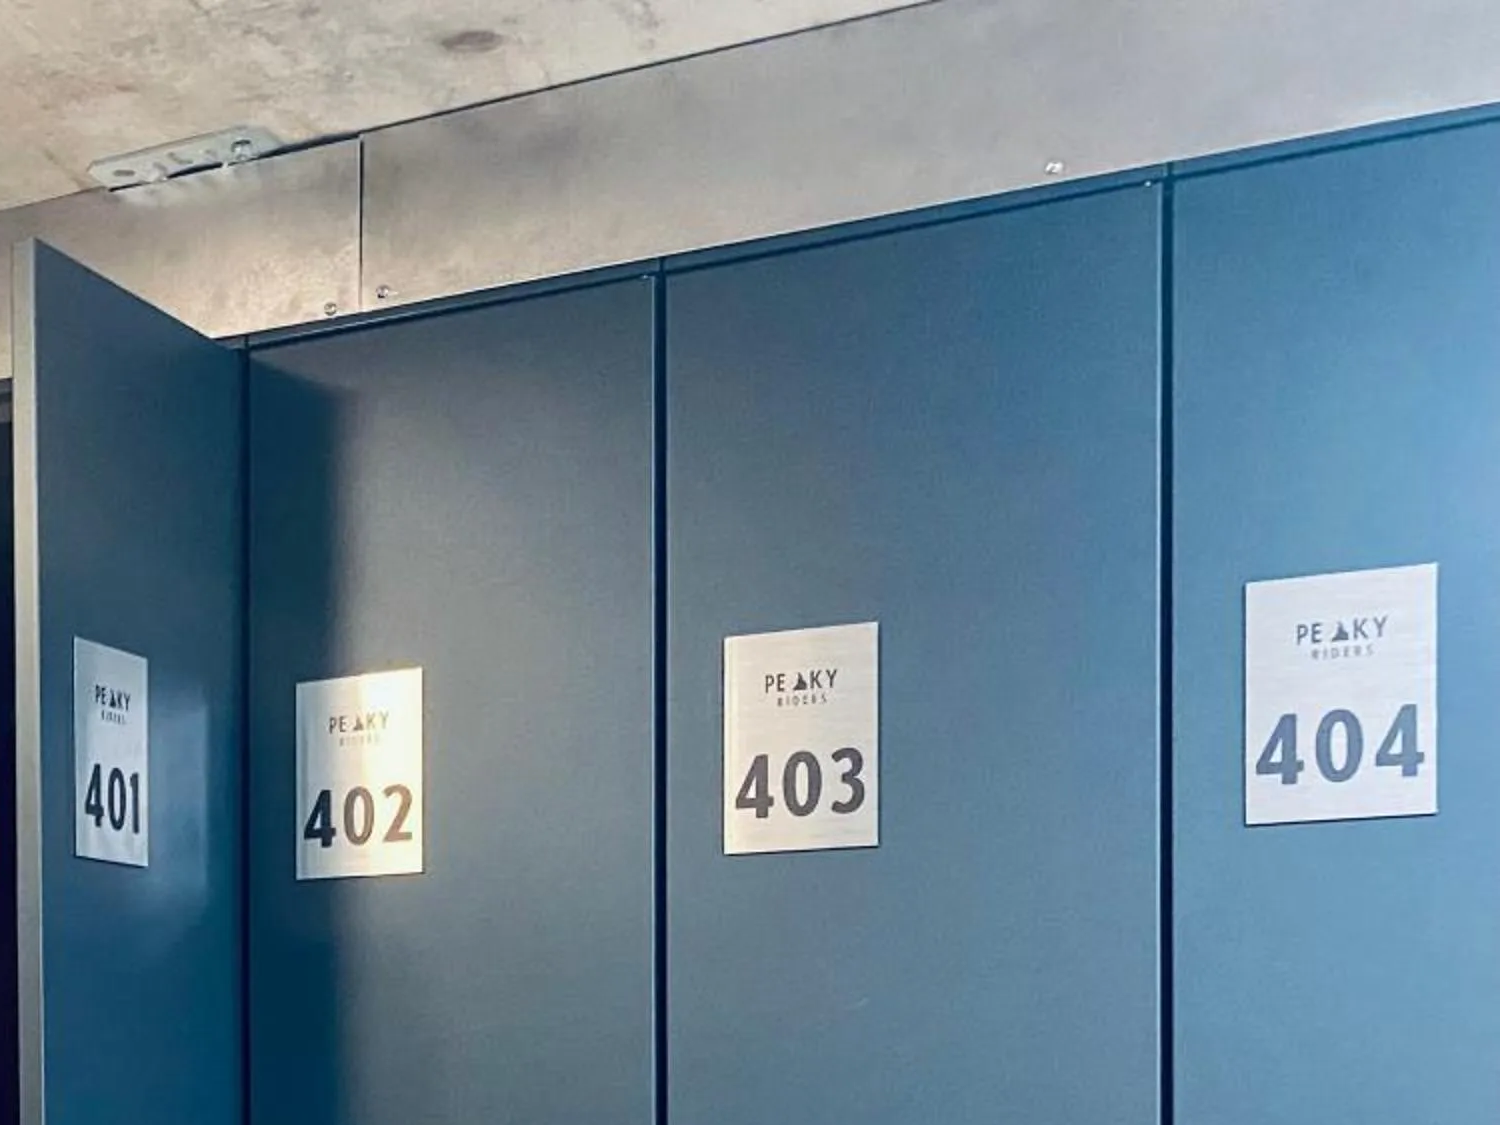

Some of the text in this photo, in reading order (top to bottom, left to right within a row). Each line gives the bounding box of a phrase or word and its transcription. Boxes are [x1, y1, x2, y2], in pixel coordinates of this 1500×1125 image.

[1296, 615, 1388, 645] PEAKY
[1311, 645, 1375, 661] RIDERS
[765, 669, 838, 694] PEAKY
[1256, 704, 1425, 785] 404
[85, 763, 140, 834] 401
[735, 747, 865, 818] 403
[305, 784, 413, 848] 402
